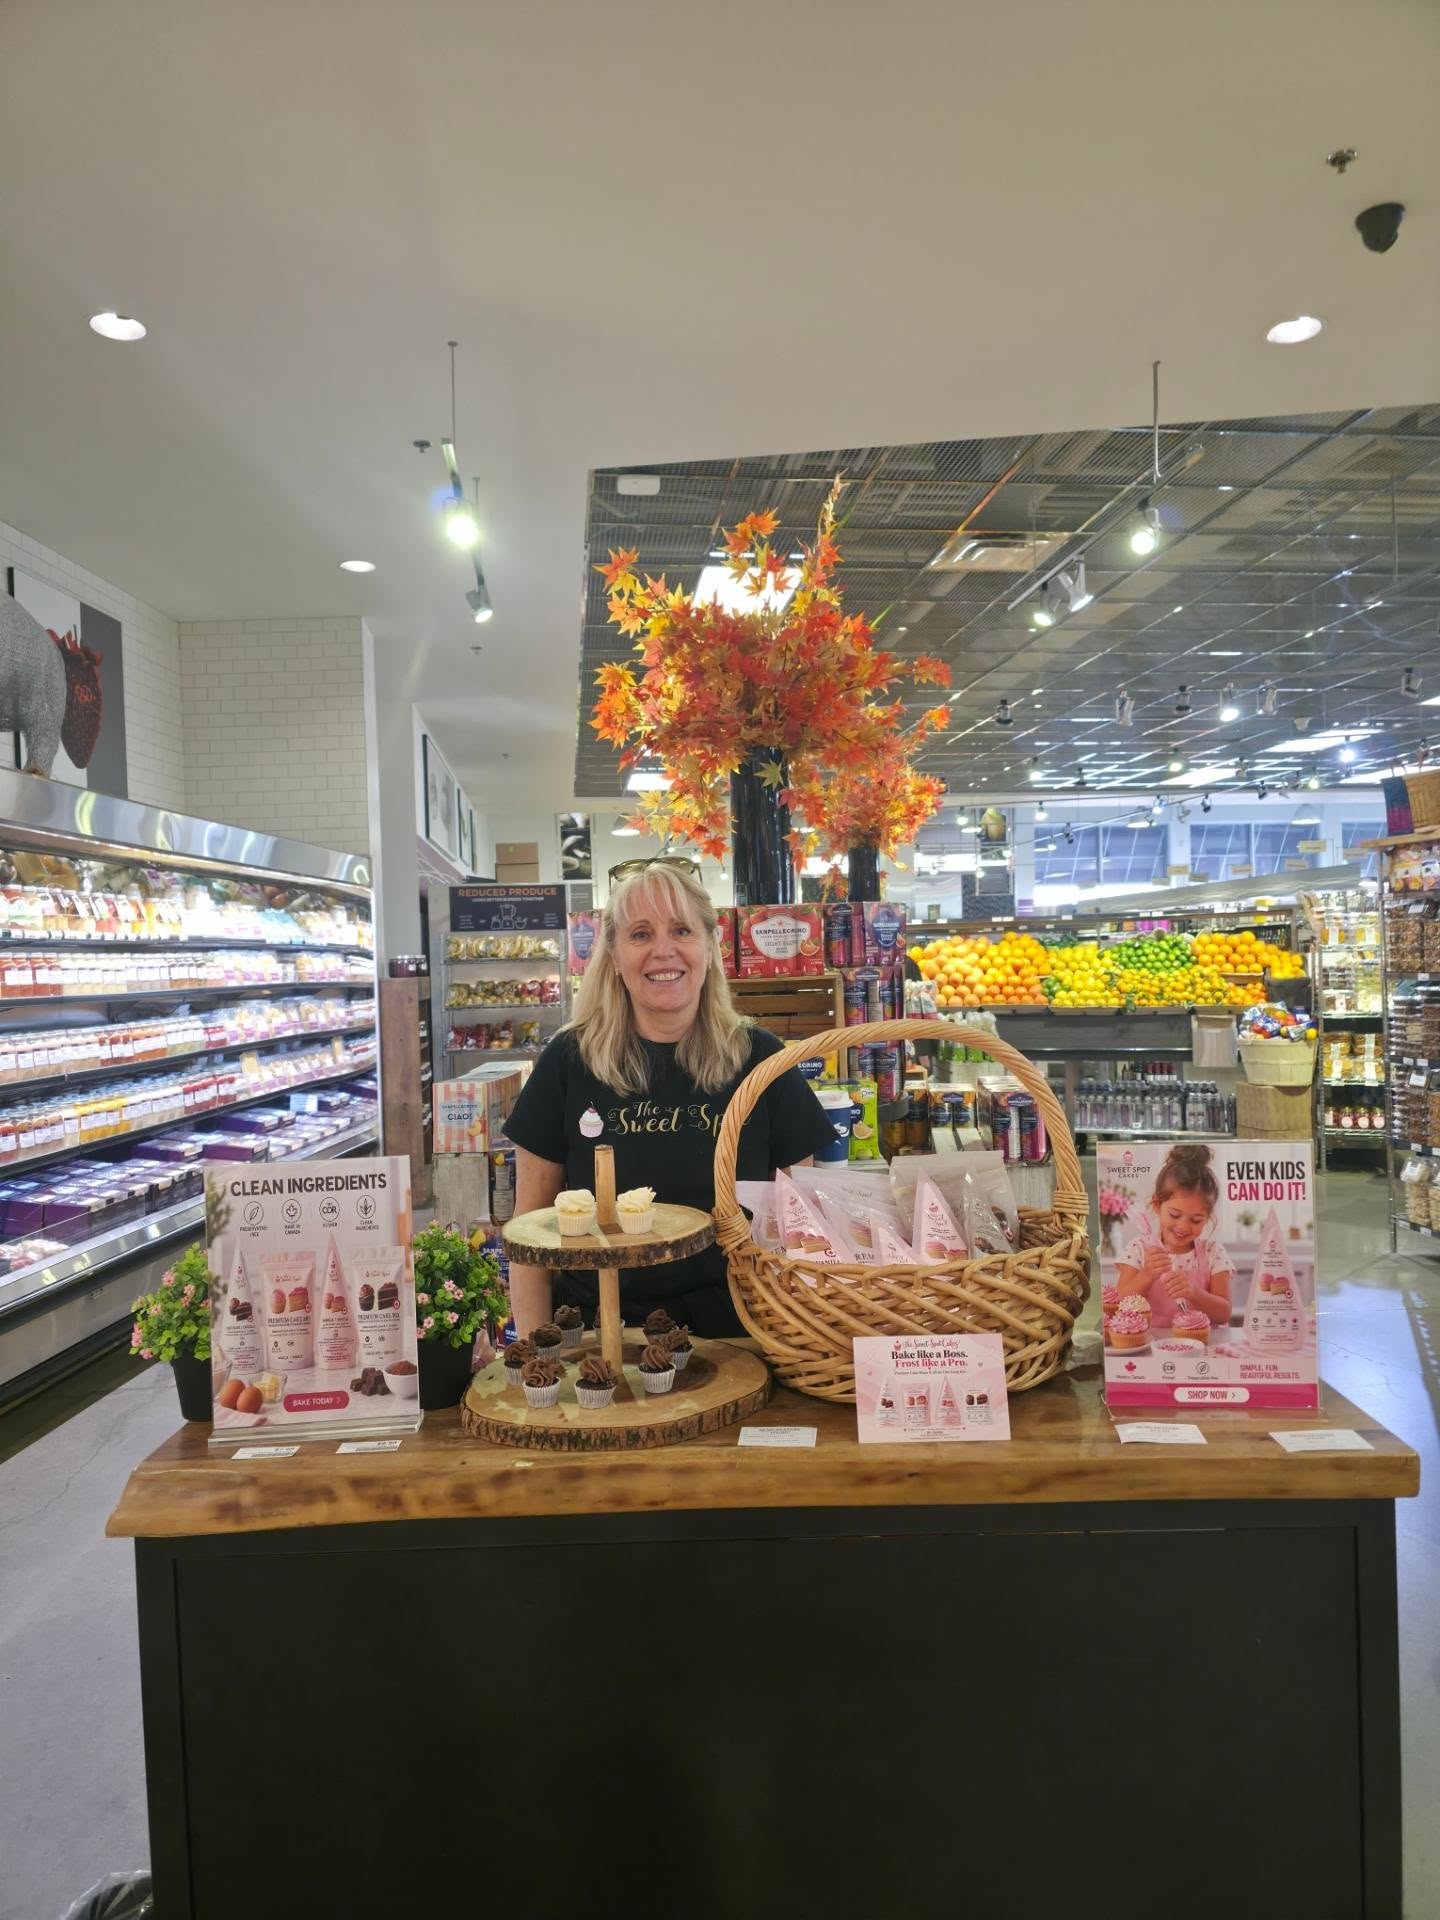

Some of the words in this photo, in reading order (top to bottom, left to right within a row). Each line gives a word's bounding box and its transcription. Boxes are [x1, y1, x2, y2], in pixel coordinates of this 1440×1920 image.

[458, 887, 506, 897] REDUCED
[508, 887, 557, 896] PRODUCE
[755, 927, 807, 936] SANPELLEGRINO
[633, 1100, 661, 1118] The
[607, 1107, 683, 1135] Sweet
[1227, 1161, 1266, 1180] EVEN
[1270, 1161, 1306, 1180] KIDS
[230, 1178, 284, 1197] CLEAN
[287, 1173, 387, 1194] INGREDIENTS
[1228, 1182, 1259, 1201] CAN
[1263, 1182, 1284, 1201] DO
[1288, 1181, 1306, 1200] IT!
[322, 1205, 337, 1215] COR
[891, 1351, 916, 1360] Bake
[916, 1350, 934, 1359] like
[943, 1349, 969, 1358] Boss.
[895, 1360, 920, 1368] Frost
[921, 1358, 939, 1367] like
[947, 1359, 968, 1367] Pro.
[1188, 1391, 1208, 1400] SHOP
[1210, 1391, 1228, 1399] NOW
[292, 1398, 311, 1407] BAKE
[312, 1397, 334, 1405] TODAY
